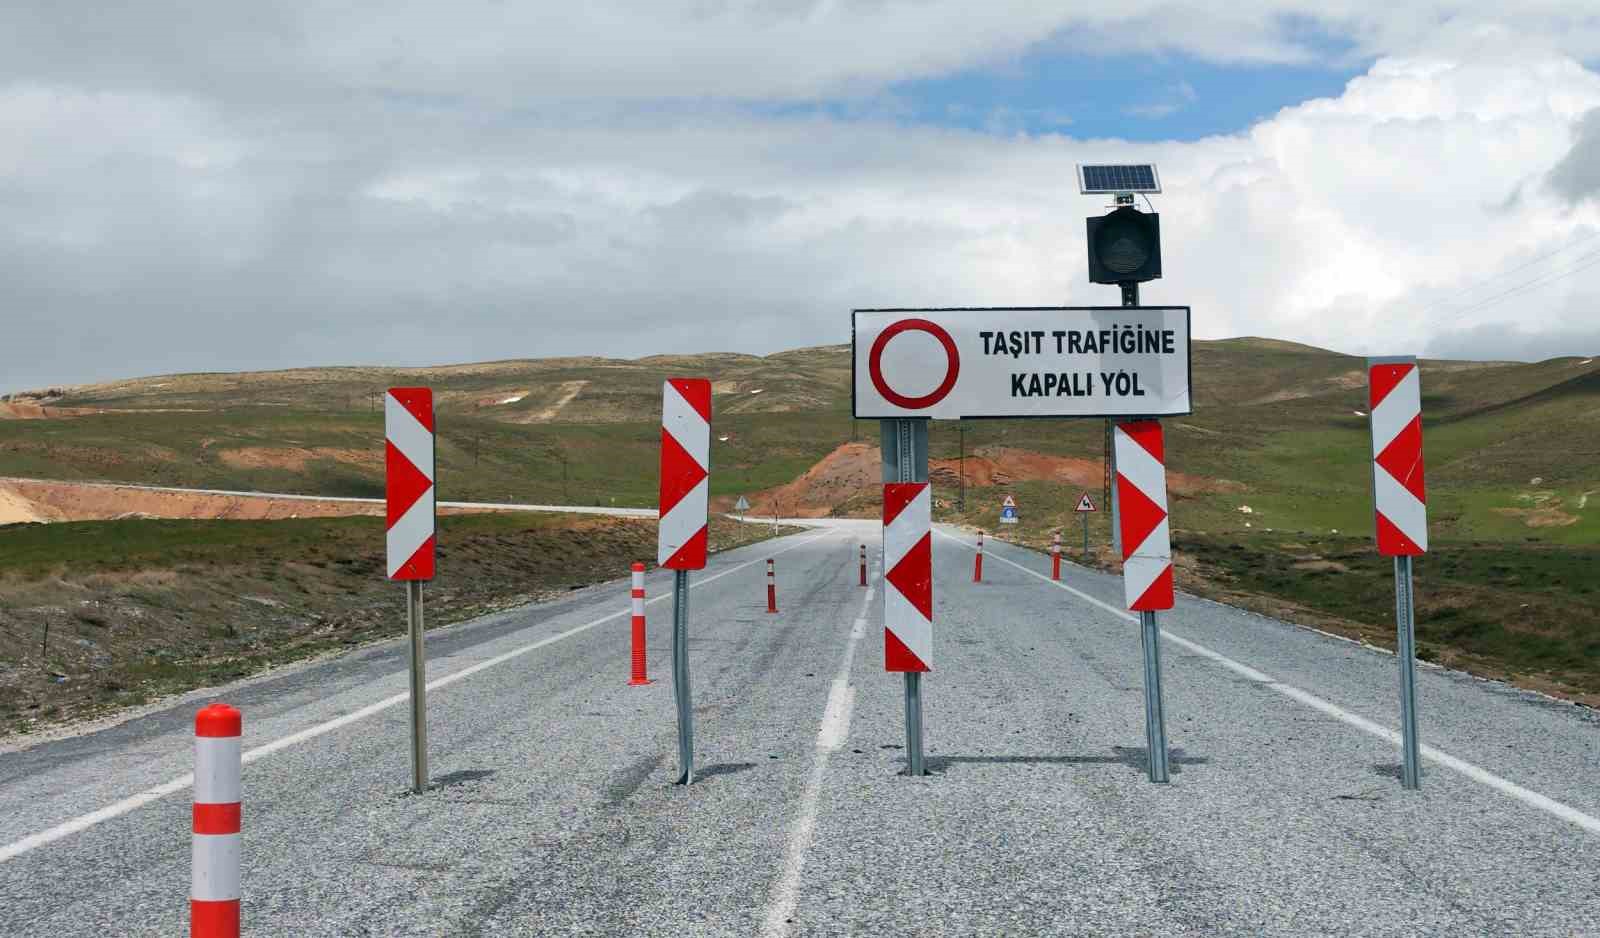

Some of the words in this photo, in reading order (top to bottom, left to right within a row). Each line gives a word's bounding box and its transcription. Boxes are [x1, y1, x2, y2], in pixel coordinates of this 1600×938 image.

[980, 331, 1045, 358] TAŞIT
[1053, 324, 1175, 354] TRAFİĞİNE
[1011, 373, 1092, 397] KAPALI
[1101, 372, 1145, 396] YOL
